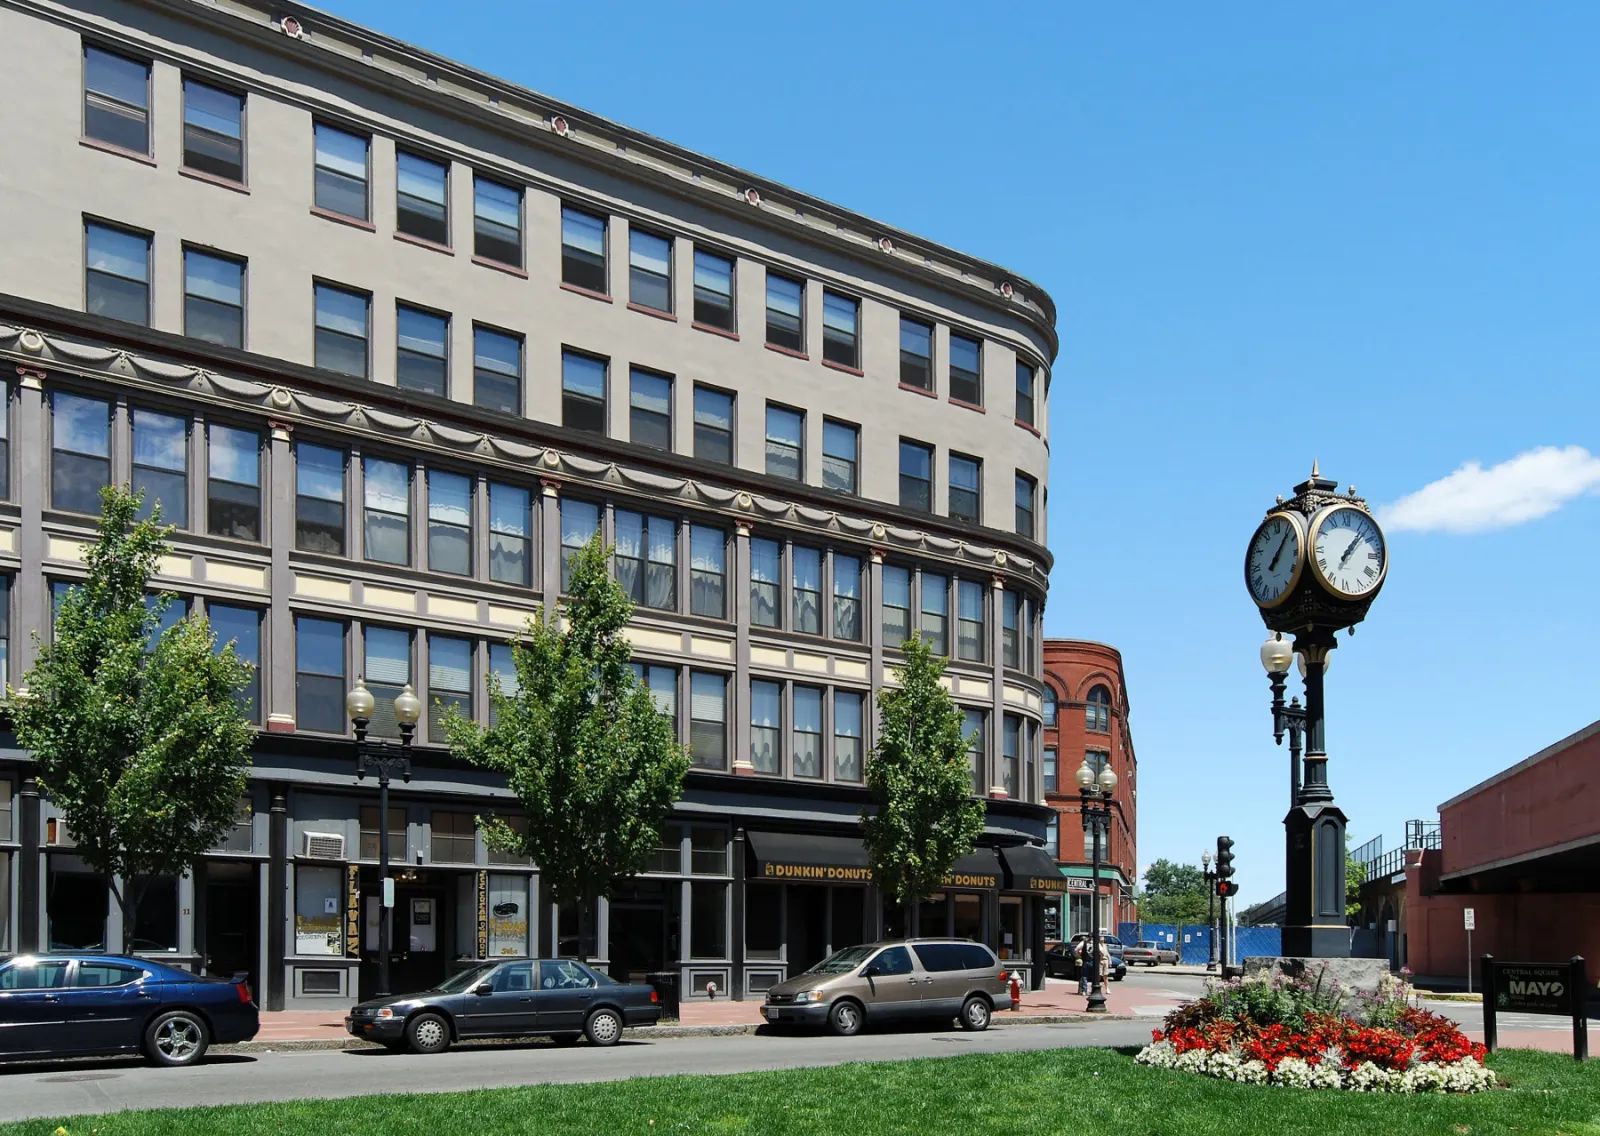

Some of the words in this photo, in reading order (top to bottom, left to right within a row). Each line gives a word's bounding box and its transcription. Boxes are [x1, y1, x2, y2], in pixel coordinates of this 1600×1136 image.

[1342, 514, 1351, 527] XII
[1368, 552, 1377, 560] III
[775, 864, 827, 878] DUNKIN'
[827, 867, 873, 880] DONUTS
[955, 875, 995, 887] DONUTS
[1069, 879, 1088, 888] CENTRAL
[347, 865, 359, 954] FLAVAZ
[1503, 968, 1533, 976] CENTRAL
[1533, 969, 1561, 977] SQUARE
[1509, 980, 1564, 997] MAYO
